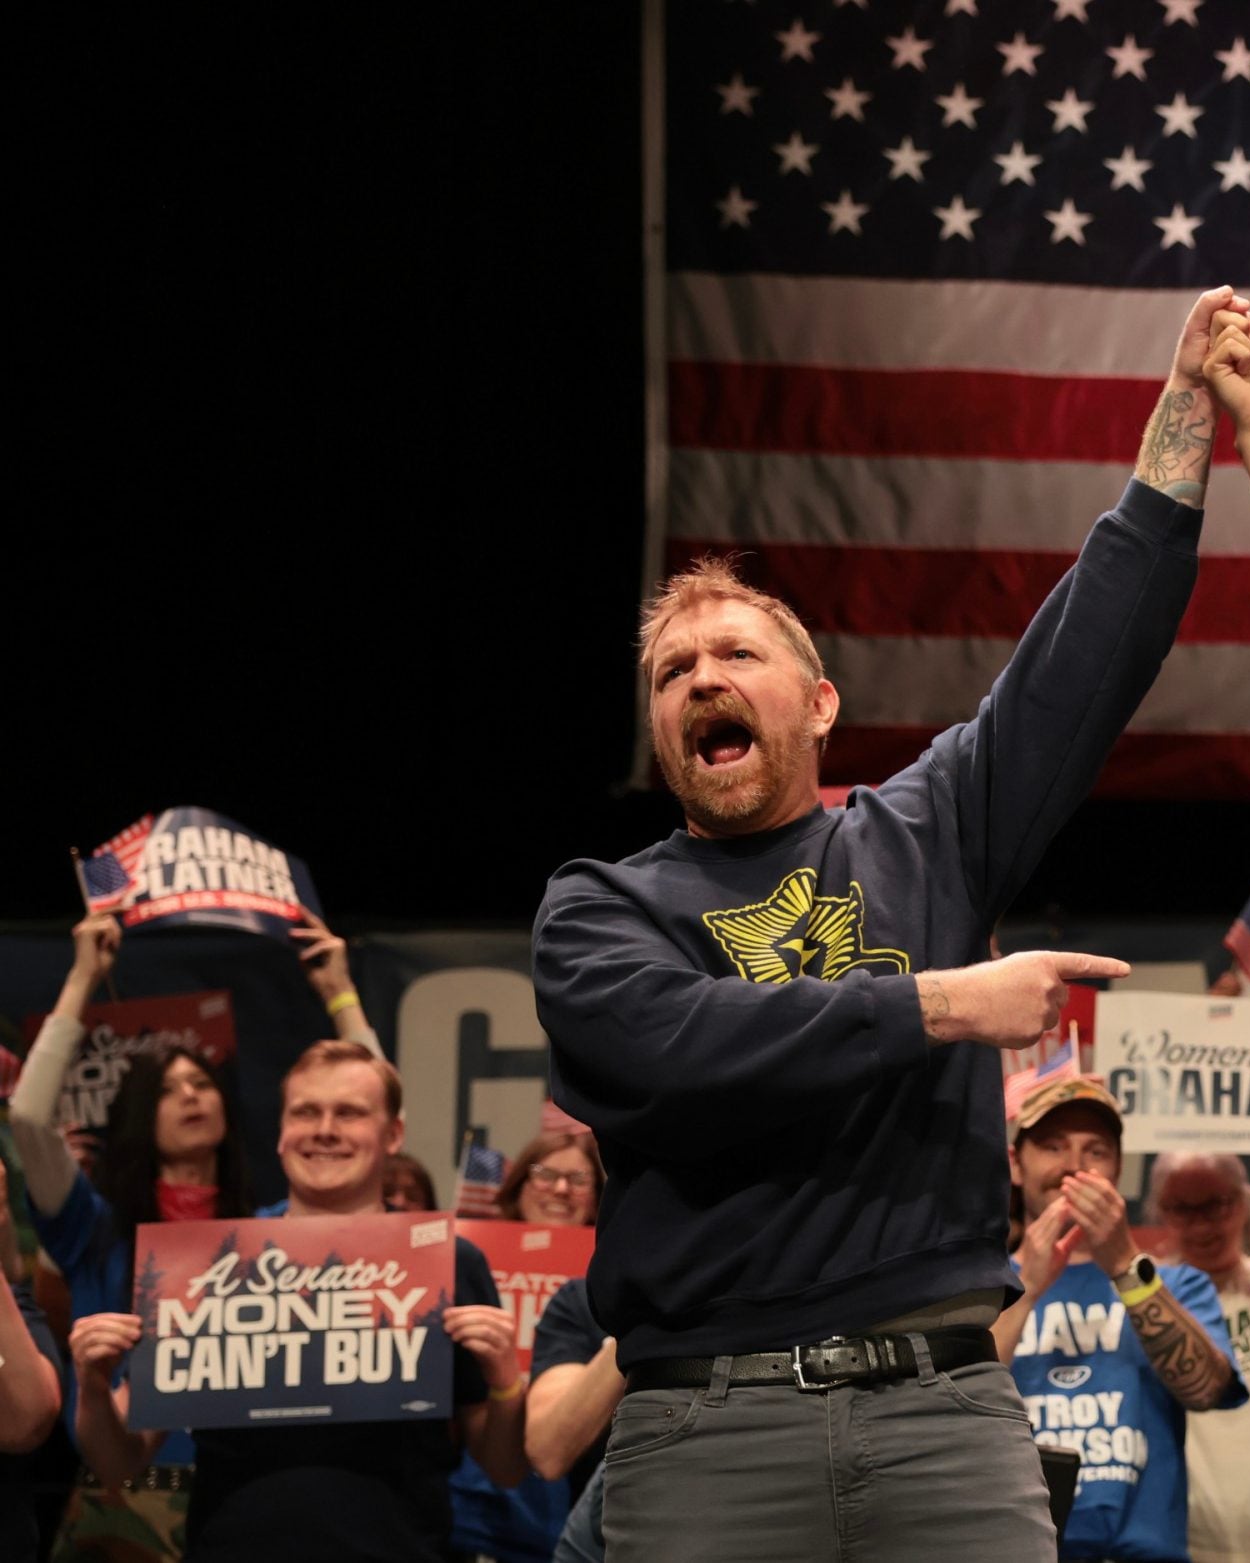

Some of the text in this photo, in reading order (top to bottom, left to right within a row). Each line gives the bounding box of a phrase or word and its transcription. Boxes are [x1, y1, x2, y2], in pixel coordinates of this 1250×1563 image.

[186, 1247, 408, 1300] A Senator
[157, 1286, 429, 1338] MONEY
[154, 1326, 428, 1394] CAN'T BUY
[1025, 1391, 1124, 1431] TROY
